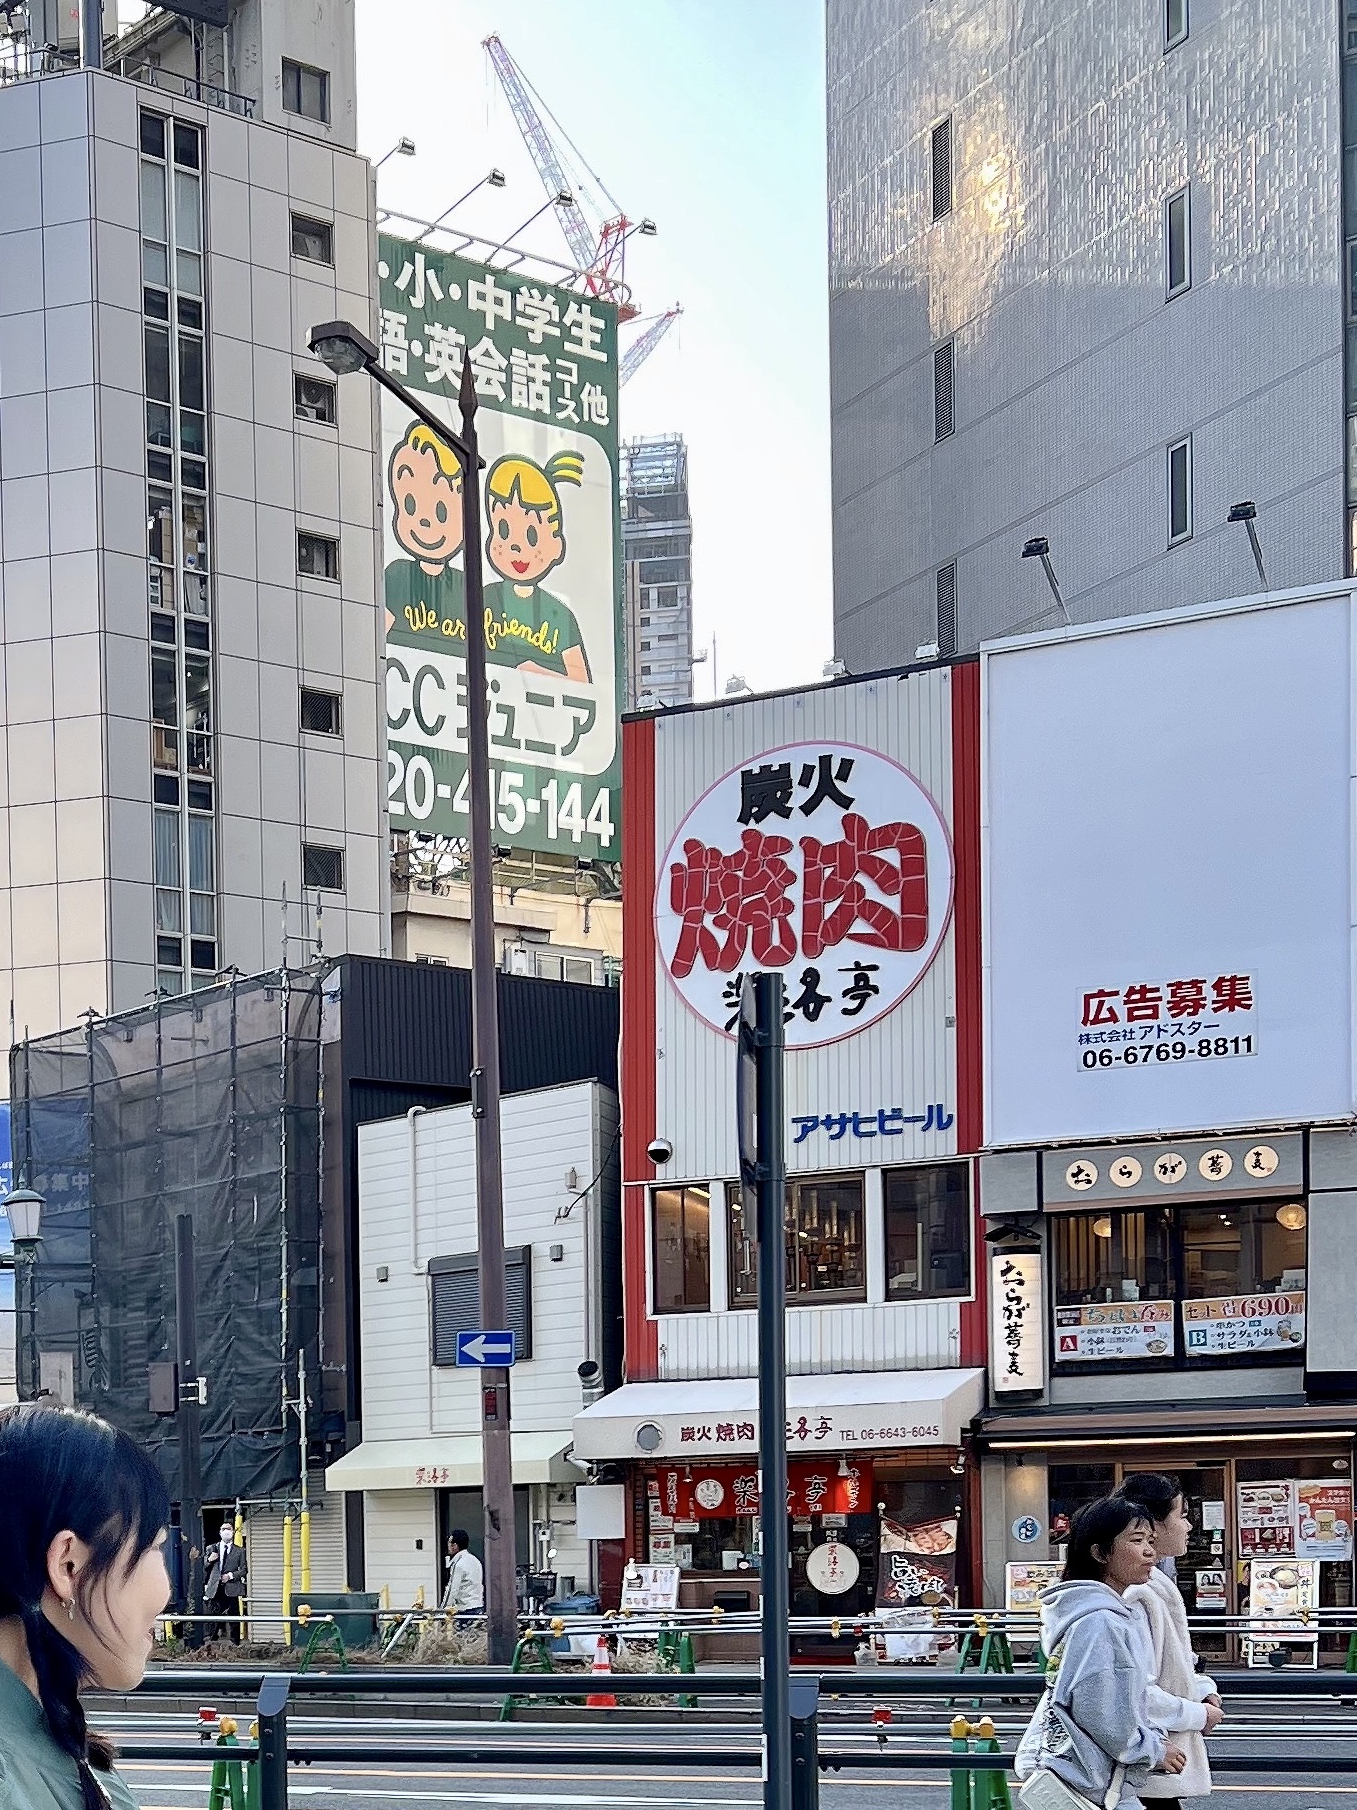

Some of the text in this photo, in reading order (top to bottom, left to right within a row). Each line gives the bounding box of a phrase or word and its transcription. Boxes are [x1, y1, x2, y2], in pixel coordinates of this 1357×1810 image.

[404, 600, 559, 656] We ar friends!
[736, 754, 855, 826] 炭火
[670, 812, 929, 979] 焼肉
[1080, 975, 1254, 1027] 広告募集
[1082, 1034, 1253, 1068] 06-6769-8811
[791, 1103, 955, 1144] アサヒビール
[1062, 1337, 1075, 1350] A
[1191, 1331, 1205, 1345] B
[681, 1423, 755, 1443] 炭火焼肉
[839, 1425, 940, 1441] TEL 06-6643-6045
